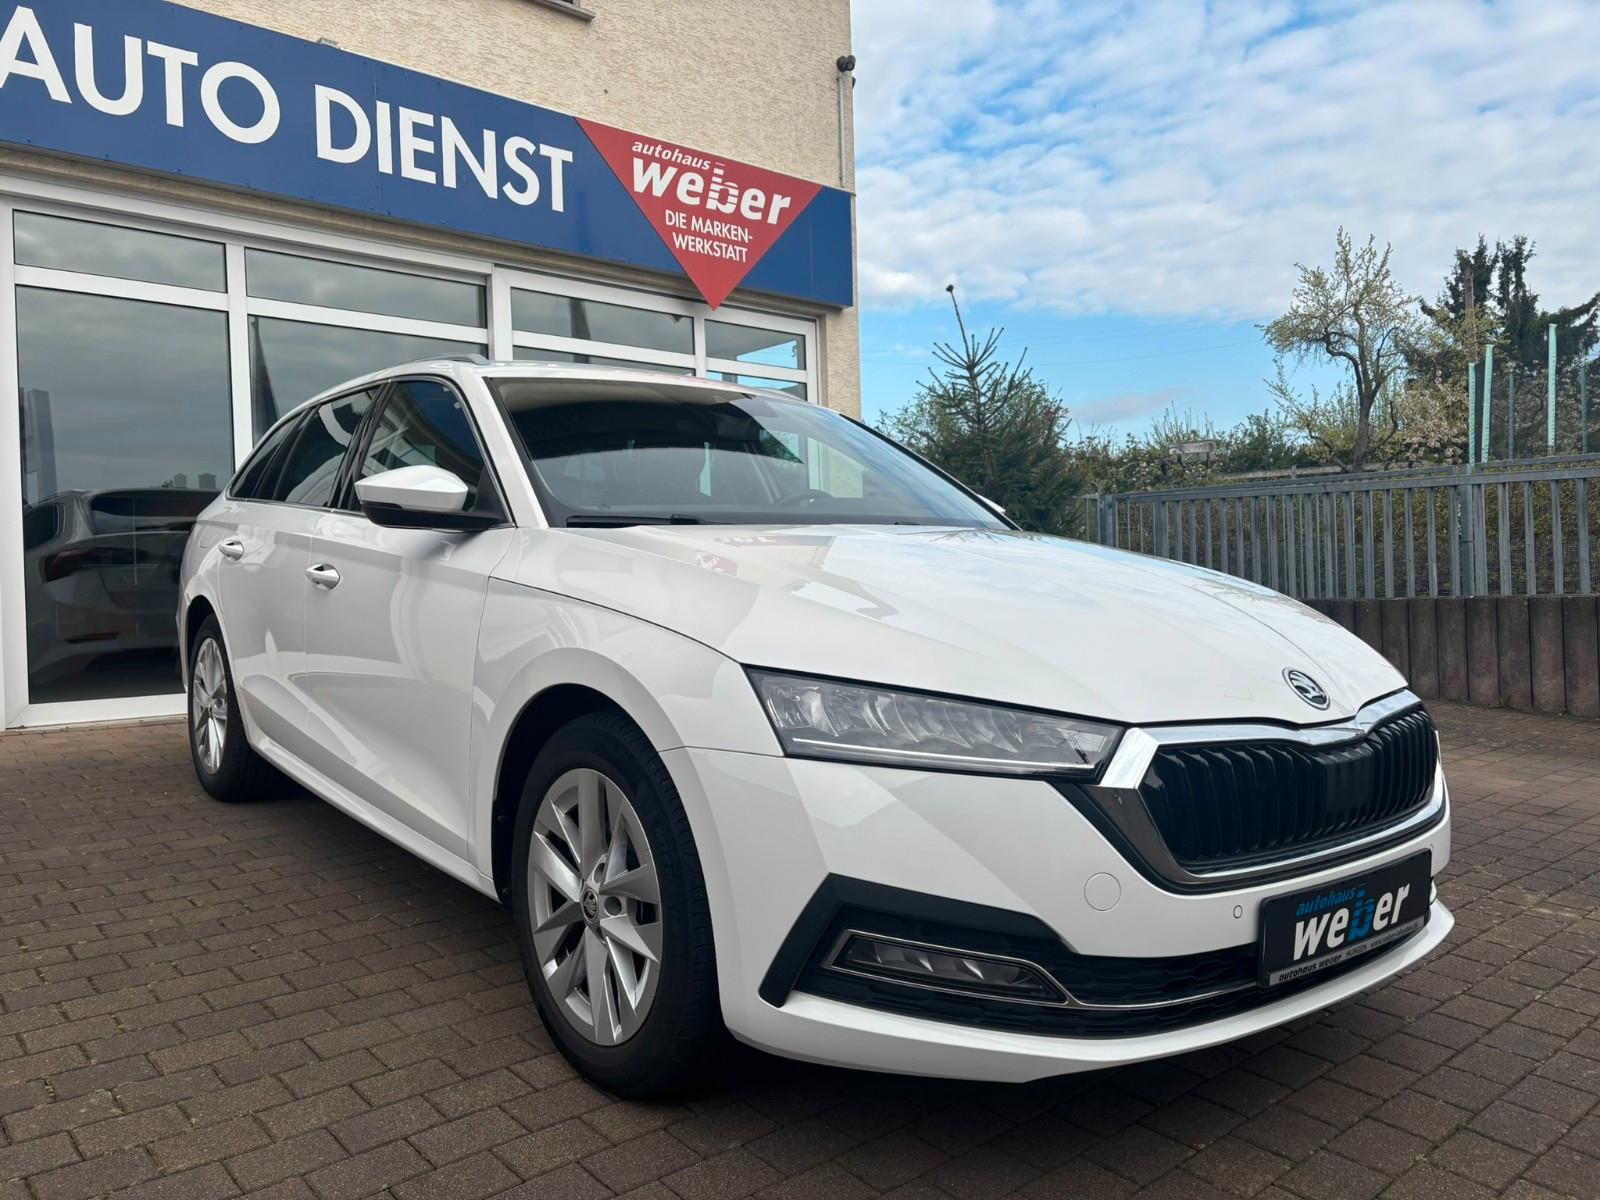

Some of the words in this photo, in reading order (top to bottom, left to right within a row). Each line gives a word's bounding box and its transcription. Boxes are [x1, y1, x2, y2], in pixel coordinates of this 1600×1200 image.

[0, 5, 280, 144] AUTO
[315, 84, 573, 212] DIENST
[632, 141, 711, 171] autohaus
[632, 157, 791, 225] weber
[665, 209, 687, 229] DIE
[691, 216, 752, 243] MARKEN-
[672, 232, 748, 263] WERKSTATT
[1296, 887, 1355, 916] autohaus
[1293, 883, 1411, 960] weber
